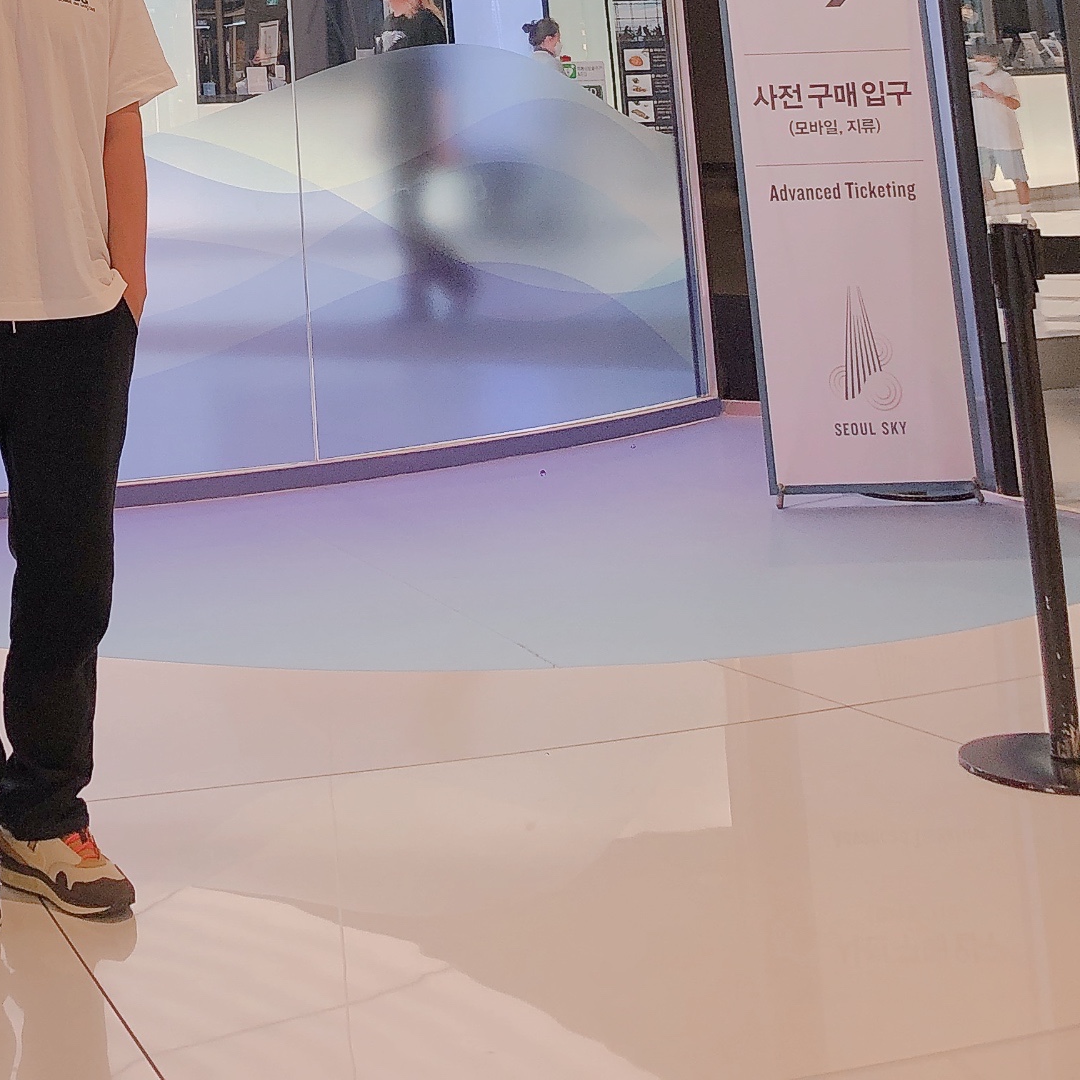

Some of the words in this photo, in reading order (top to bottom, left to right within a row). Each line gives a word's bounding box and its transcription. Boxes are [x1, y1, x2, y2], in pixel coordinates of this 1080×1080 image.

[753, 83, 803, 111] 사전
[807, 81, 858, 109] 구매
[861, 80, 913, 107] 입구
[789, 119, 843, 137] (모바일,
[846, 118, 881, 135] 지류)
[770, 182, 841, 202] Advanced
[844, 181, 917, 202] Ticketing
[834, 422, 876, 437] SEOUL
[881, 421, 907, 436] SKY
